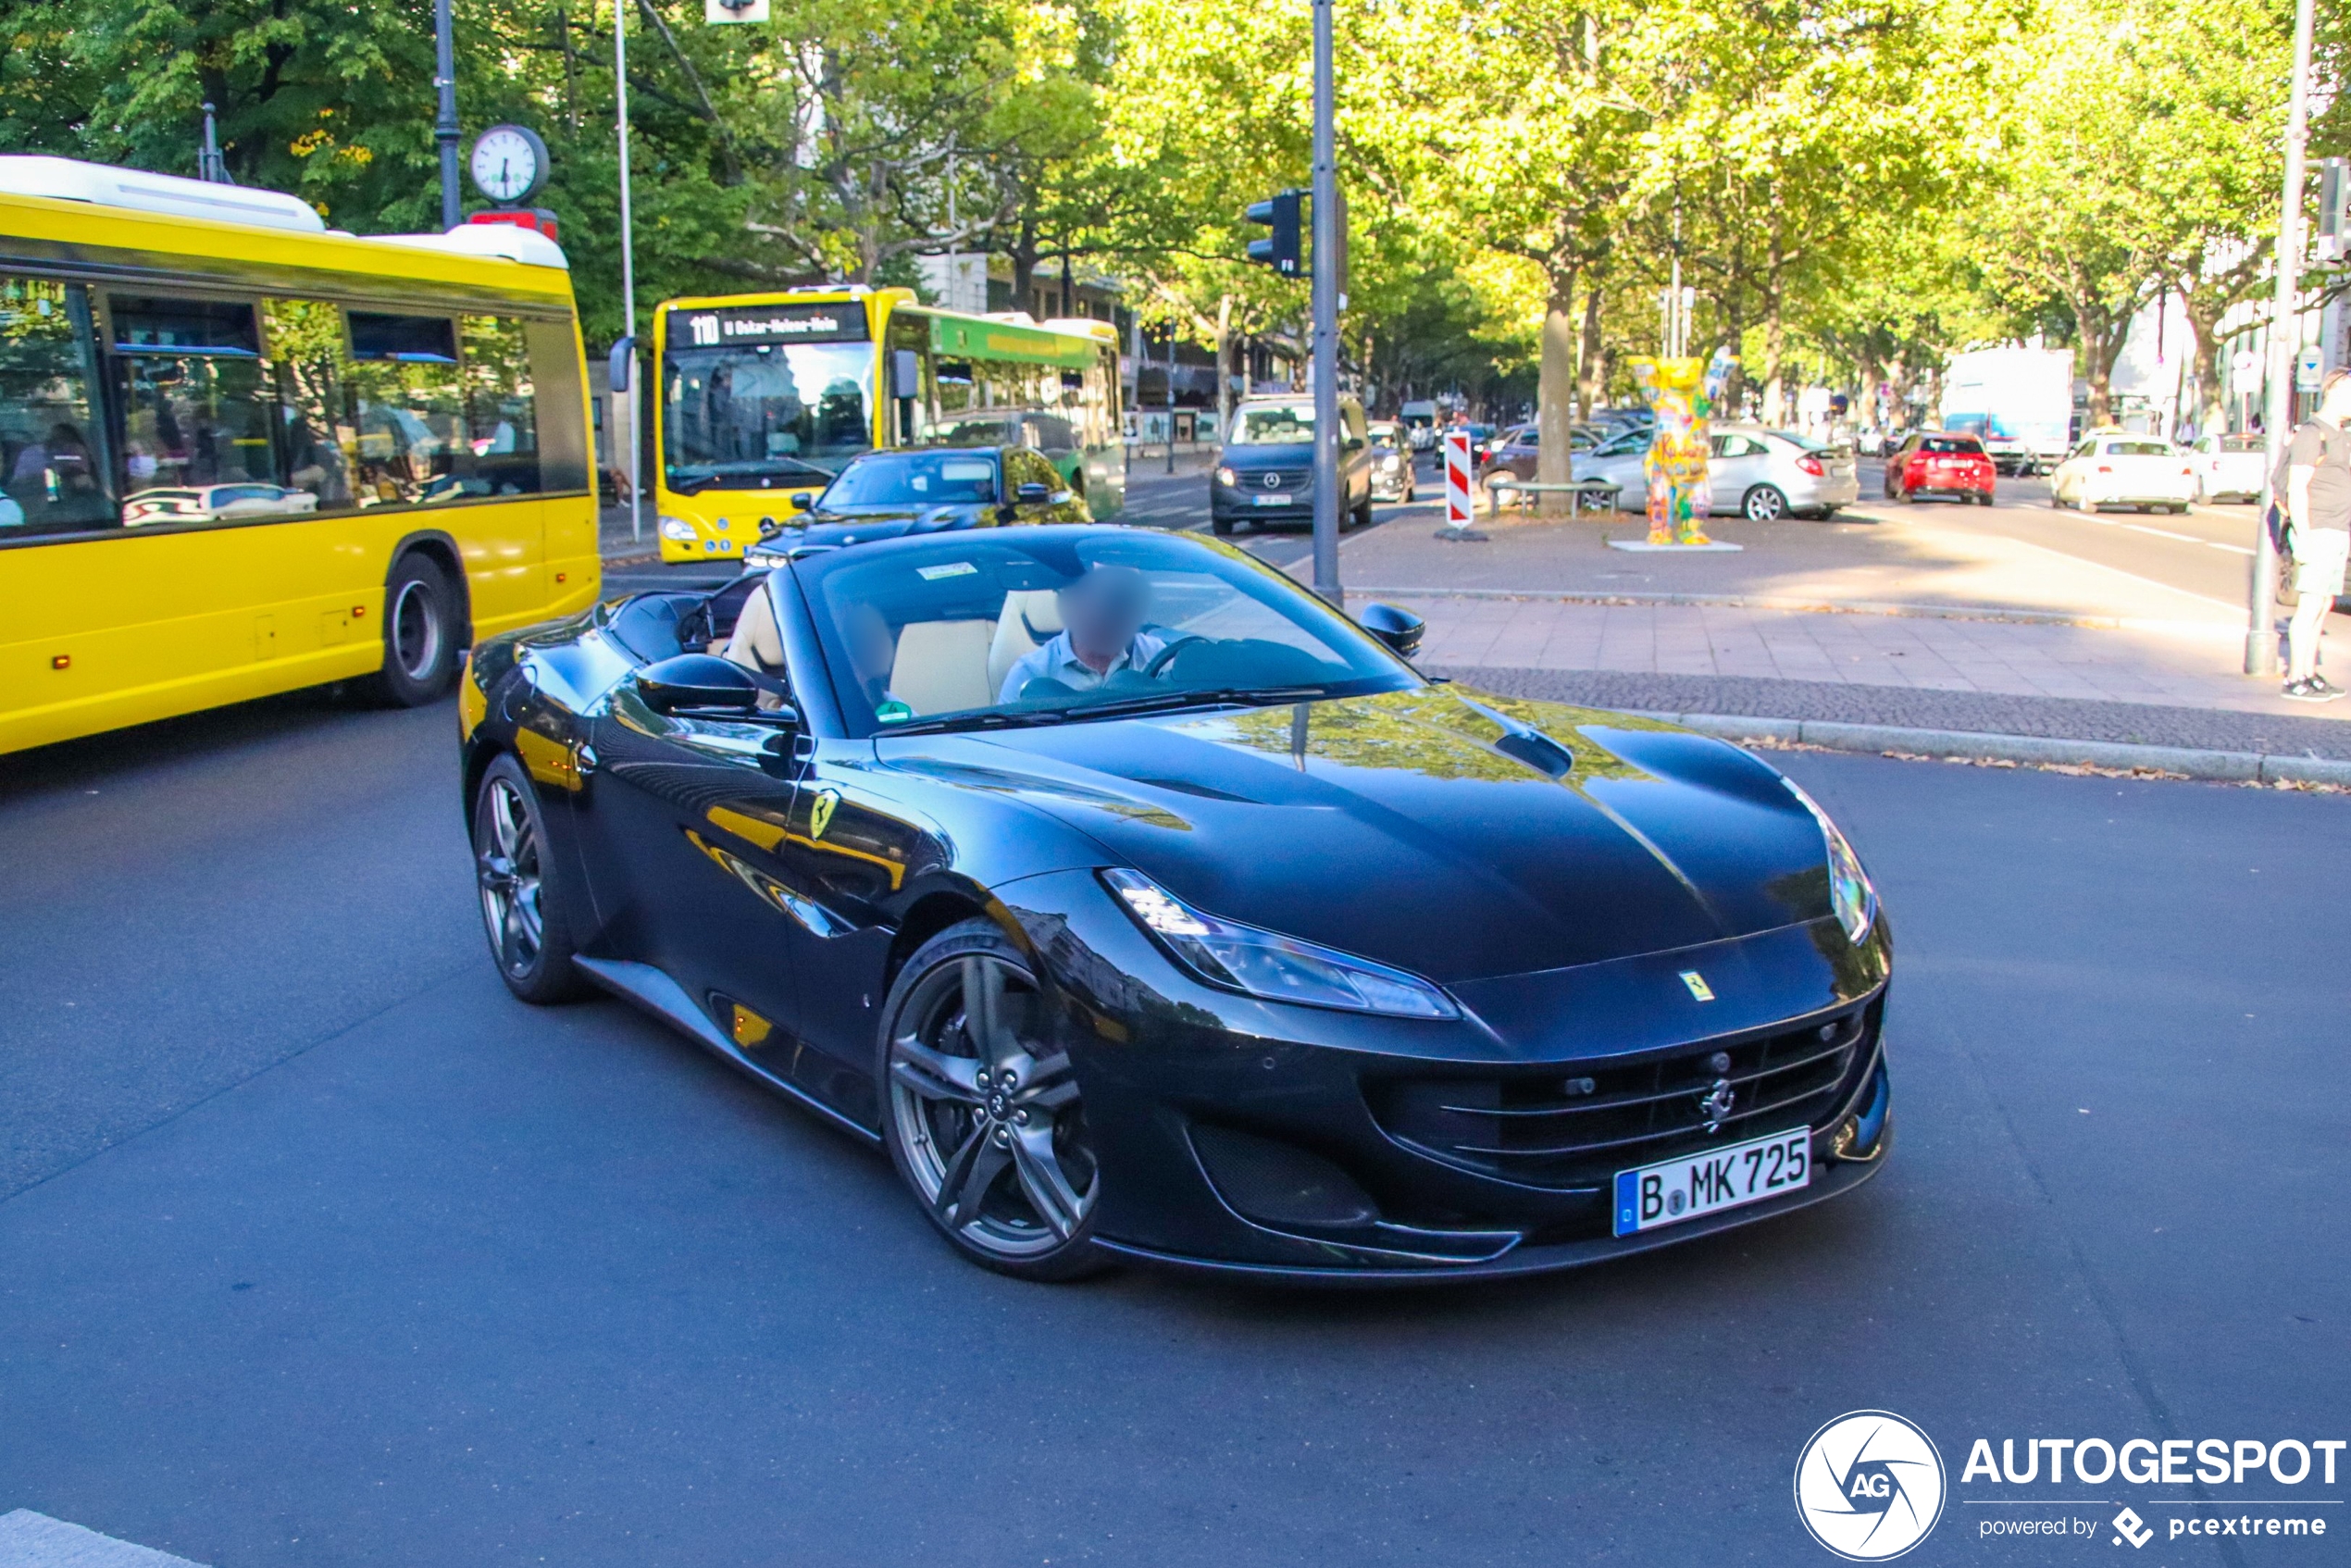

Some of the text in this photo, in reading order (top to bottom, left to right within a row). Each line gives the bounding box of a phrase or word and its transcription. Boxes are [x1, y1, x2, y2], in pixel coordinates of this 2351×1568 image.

[690, 315, 720, 345] 110
[1641, 1137, 1806, 1221] B MK 725
